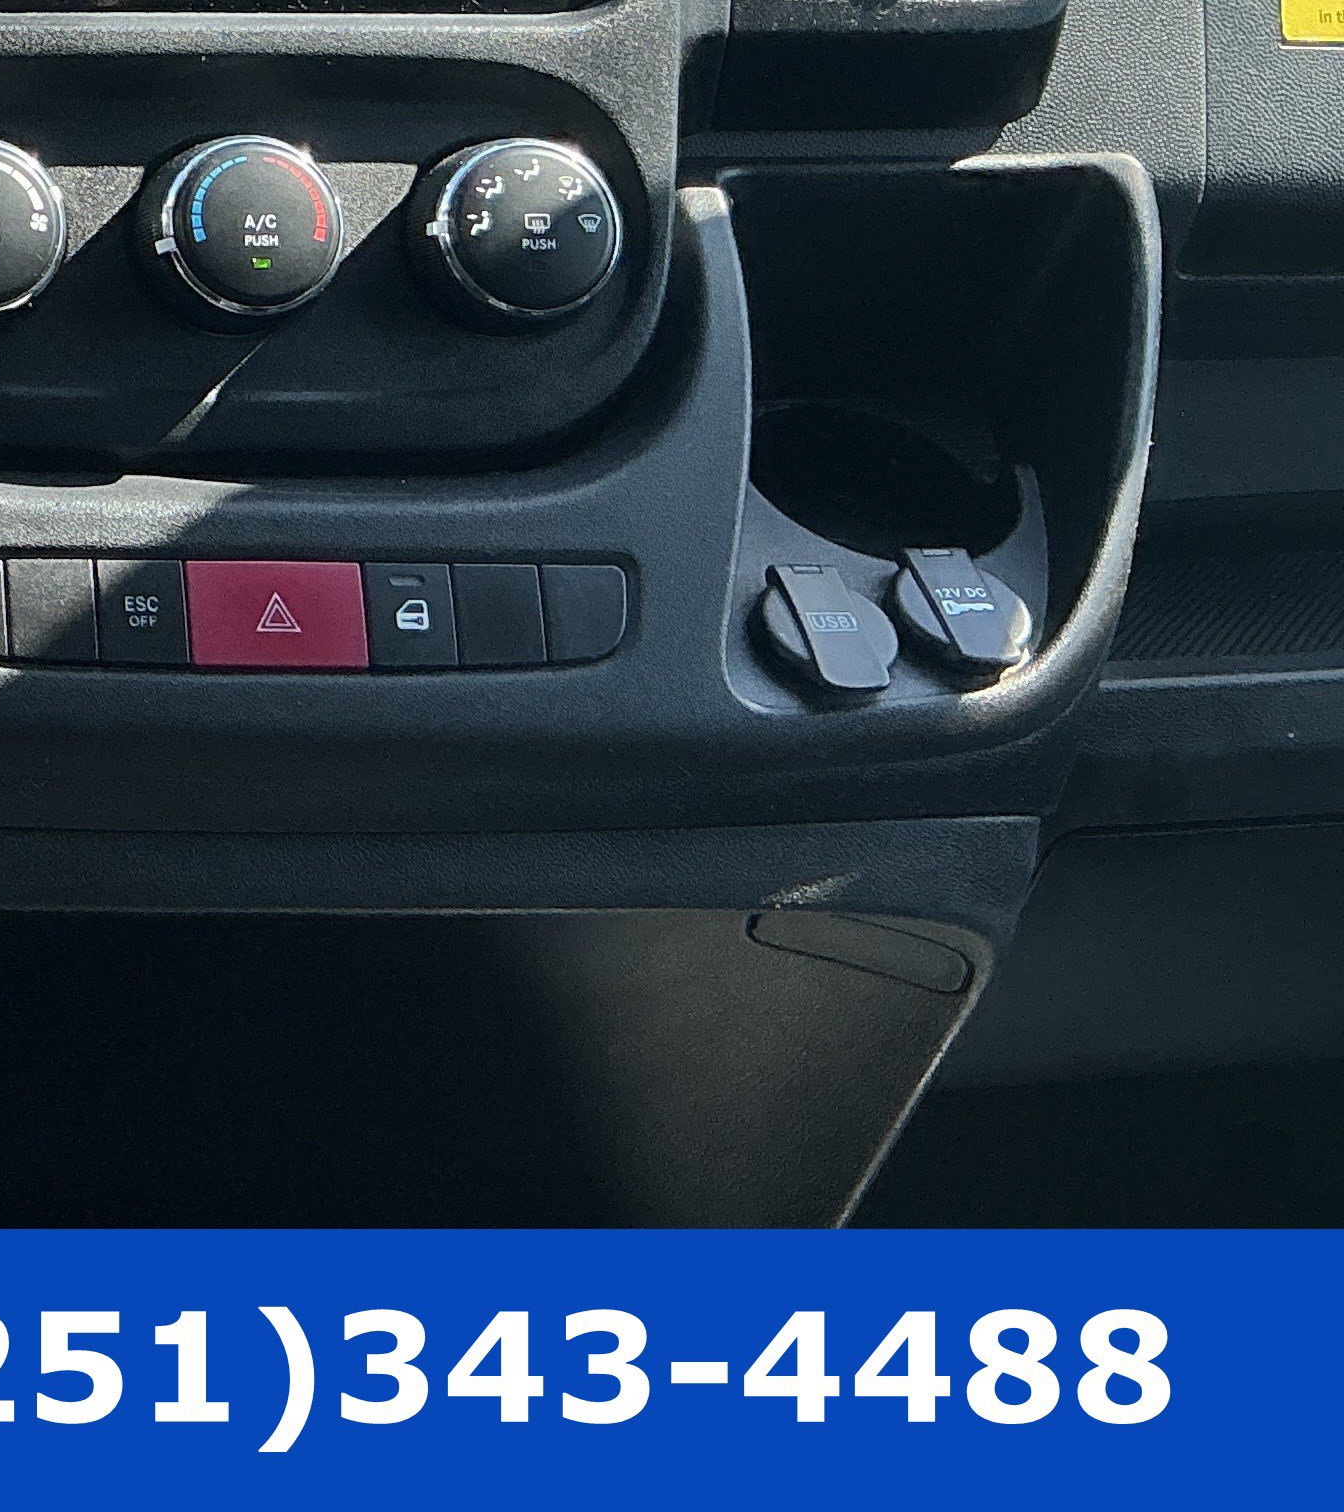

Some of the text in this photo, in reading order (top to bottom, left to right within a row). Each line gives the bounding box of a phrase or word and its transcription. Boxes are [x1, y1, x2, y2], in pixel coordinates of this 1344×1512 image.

[1319, 9, 1333, 24] in
[243, 214, 277, 232] A/C
[244, 235, 279, 247] PUSH
[521, 238, 557, 251] PUSH
[934, 587, 987, 599] 12V DC
[124, 595, 159, 613] ESC
[129, 615, 158, 627] OFF
[812, 616, 853, 630] USB
